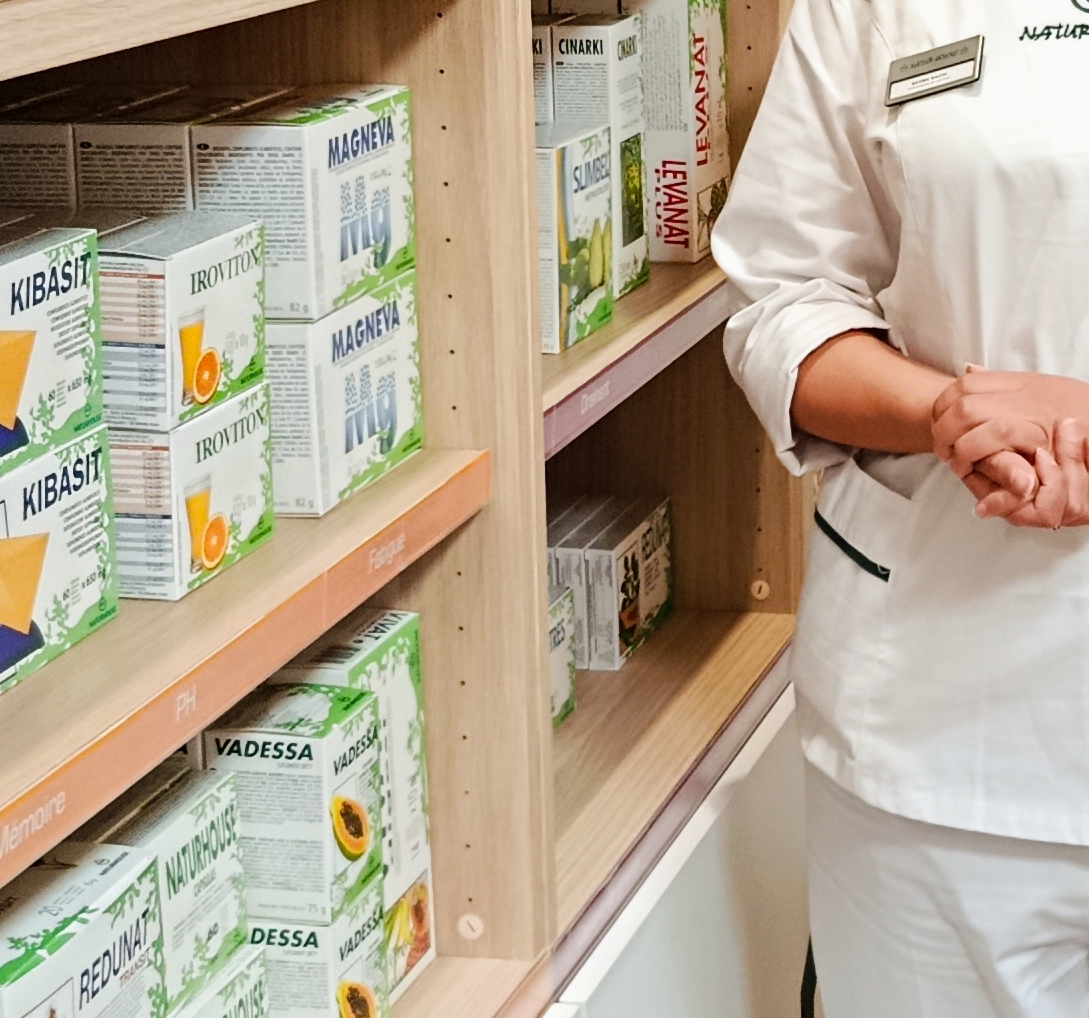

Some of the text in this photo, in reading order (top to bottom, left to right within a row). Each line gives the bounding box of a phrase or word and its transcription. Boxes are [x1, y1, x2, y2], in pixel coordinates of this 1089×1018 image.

[559, 38, 604, 55] CINARKI
[694, 34, 710, 167] LEVANAT
[328, 115, 395, 169] MAGNEVA
[573, 149, 611, 194] SLIMBEL
[662, 159, 690, 249] LEVANAT
[11, 252, 91, 315] KIBASIT
[290, 302, 300, 312] 82
[332, 300, 400, 362] MAGNEVA
[23, 447, 102, 521] KIBASIT
[295, 498, 306, 508] 82
[176, 685, 196, 721] PH
[215, 738, 313, 761] VADESSA
[334, 725, 378, 775] VADESSA
[165, 804, 237, 900] NATURHOUSE
[307, 904, 318, 913] 75
[339, 906, 383, 961] VADESSA
[79, 908, 150, 1011] REDUNAT
[250, 927, 319, 948] DESSA
